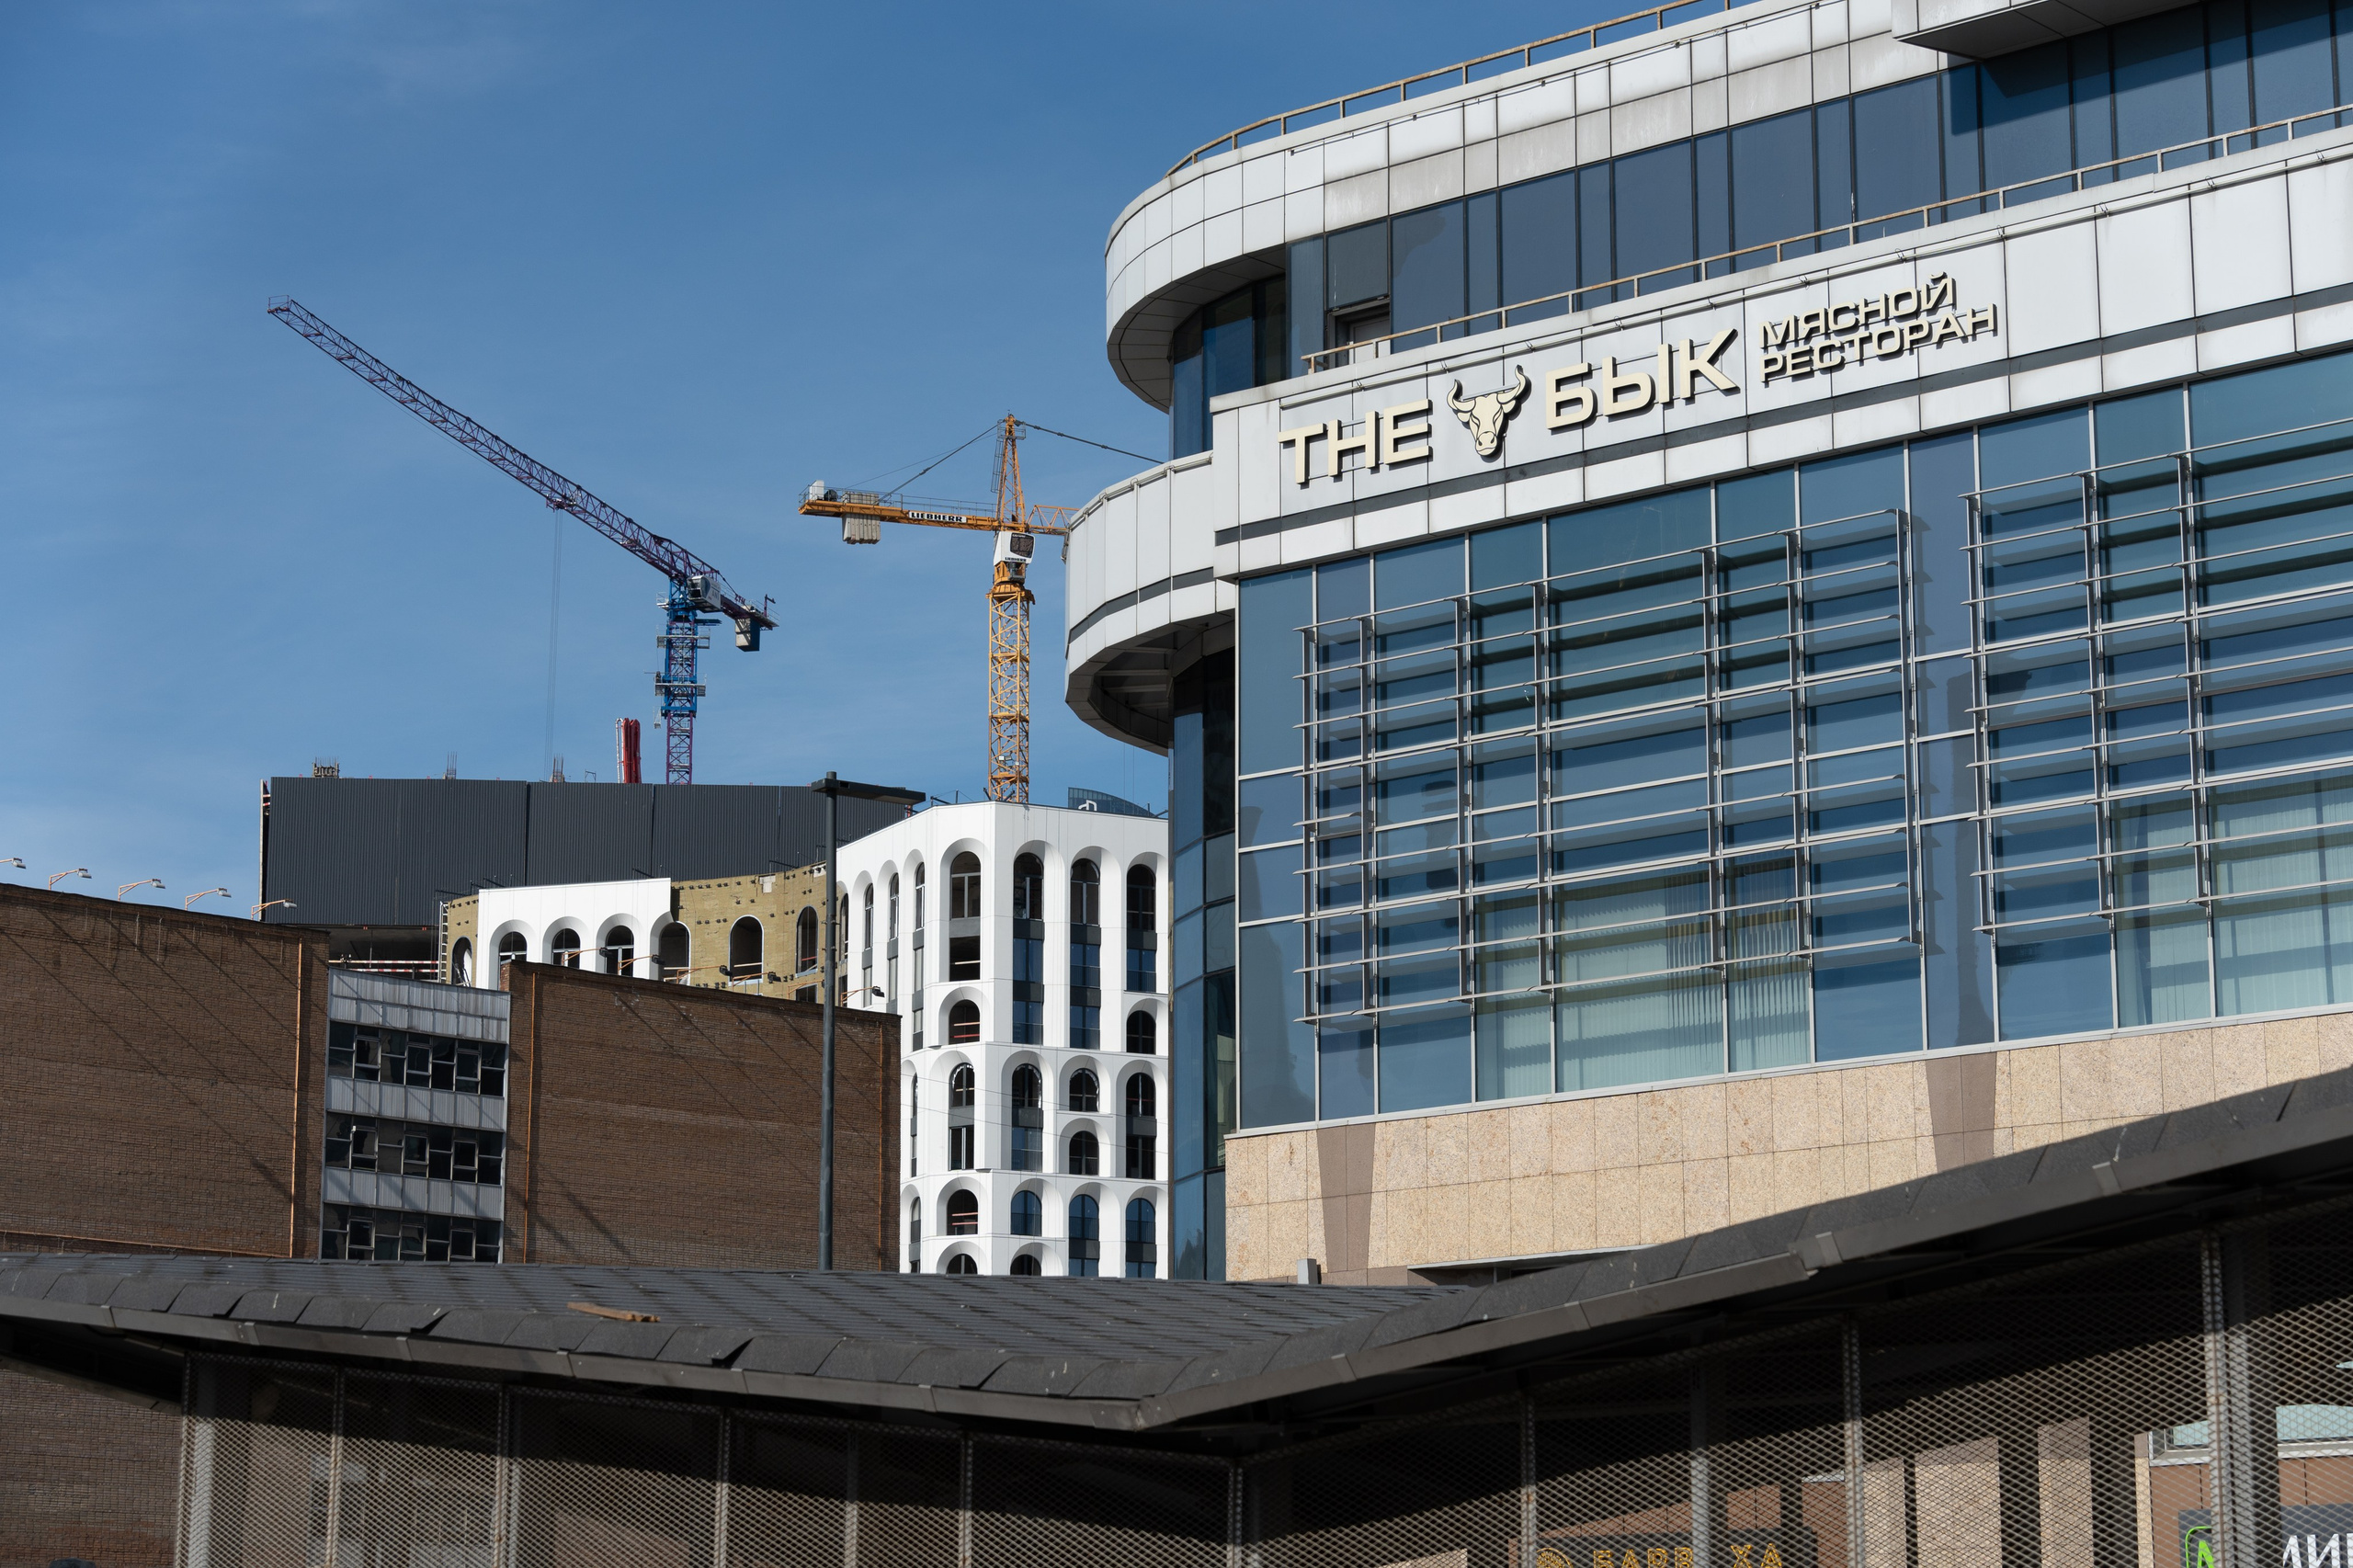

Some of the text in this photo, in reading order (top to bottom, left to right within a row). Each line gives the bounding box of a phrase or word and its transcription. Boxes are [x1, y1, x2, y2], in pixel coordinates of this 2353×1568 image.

[1759, 271, 1955, 349] МЯСНОЙ
[1759, 303, 1996, 383] РЕСТОРАН
[1278, 328, 1740, 485] THE БЫК
[911, 512, 963, 522] LIEBHERR
[1594, 1542, 1782, 1568] БАРВХА
